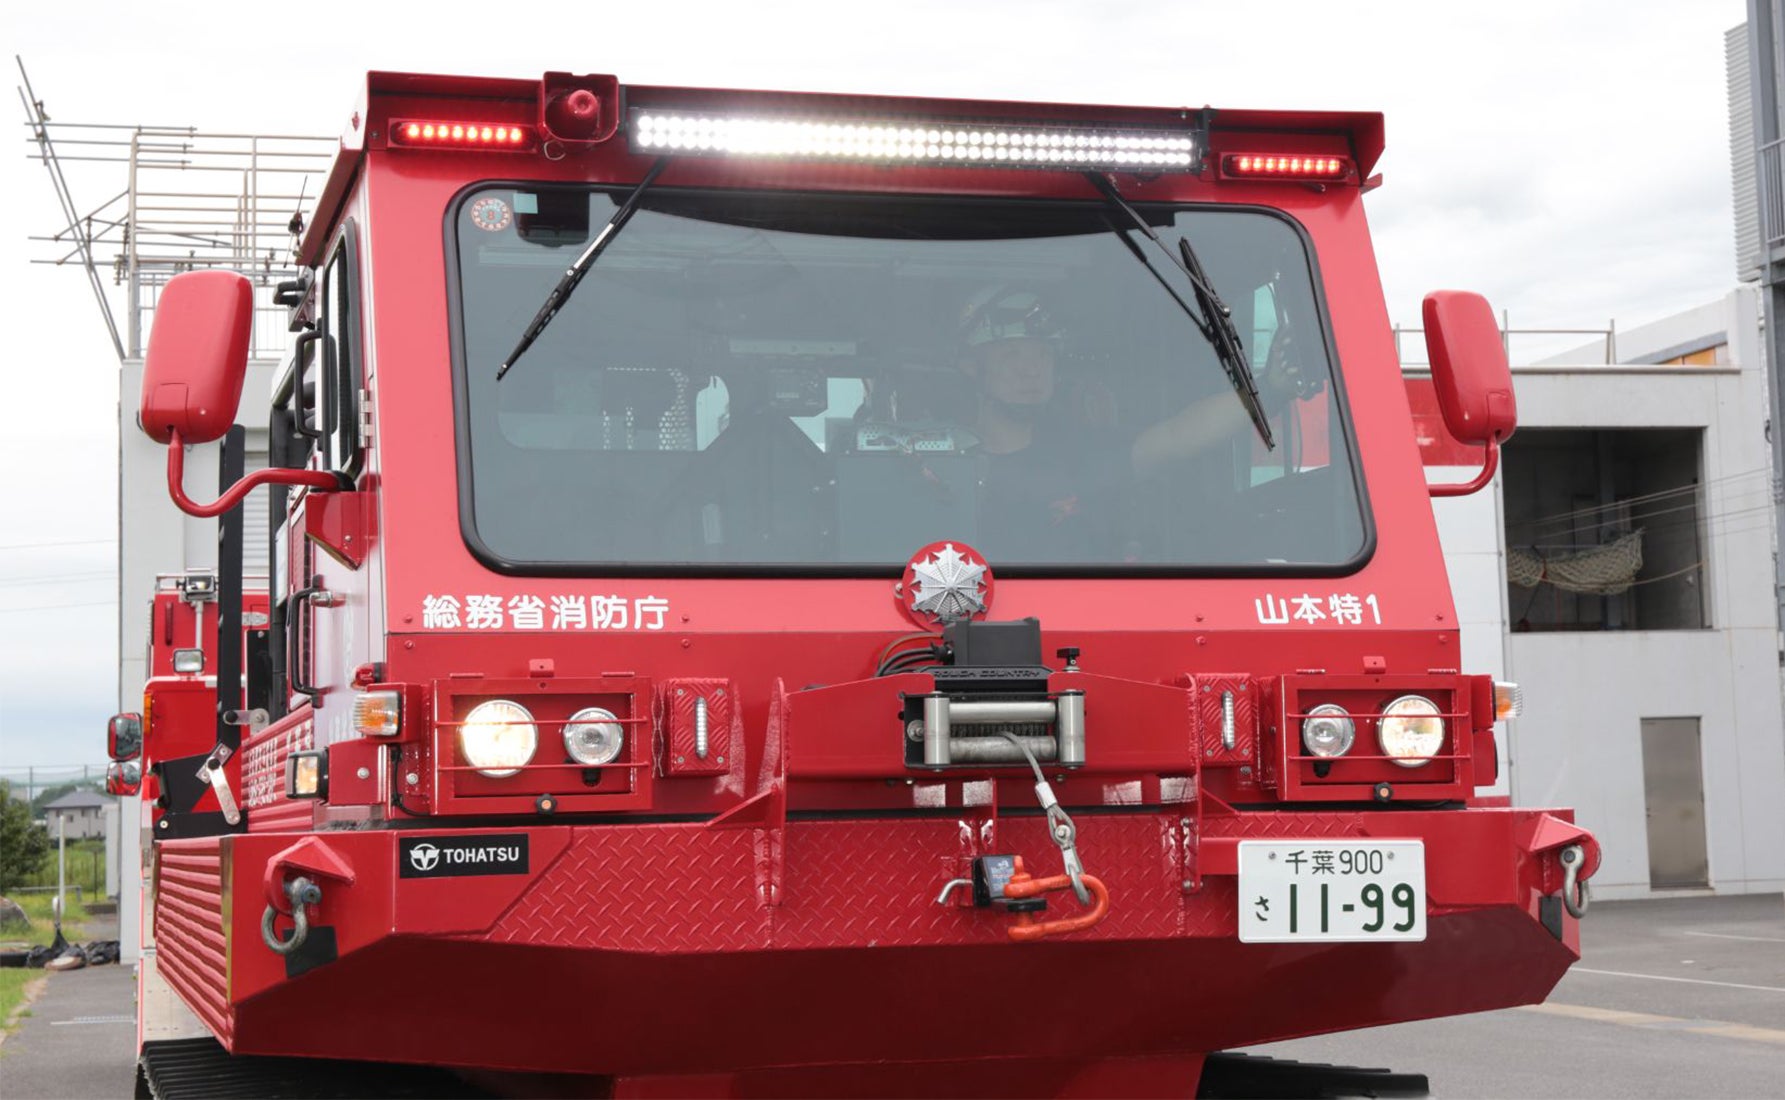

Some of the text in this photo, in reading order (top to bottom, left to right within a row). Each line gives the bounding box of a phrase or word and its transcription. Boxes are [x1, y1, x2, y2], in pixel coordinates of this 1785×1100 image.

[422, 594, 669, 630] 総務省消防庁
[1255, 593, 1381, 625] 山本特1
[443, 847, 519, 864] TOHATSU
[1255, 883, 1415, 933] さ 11-99
